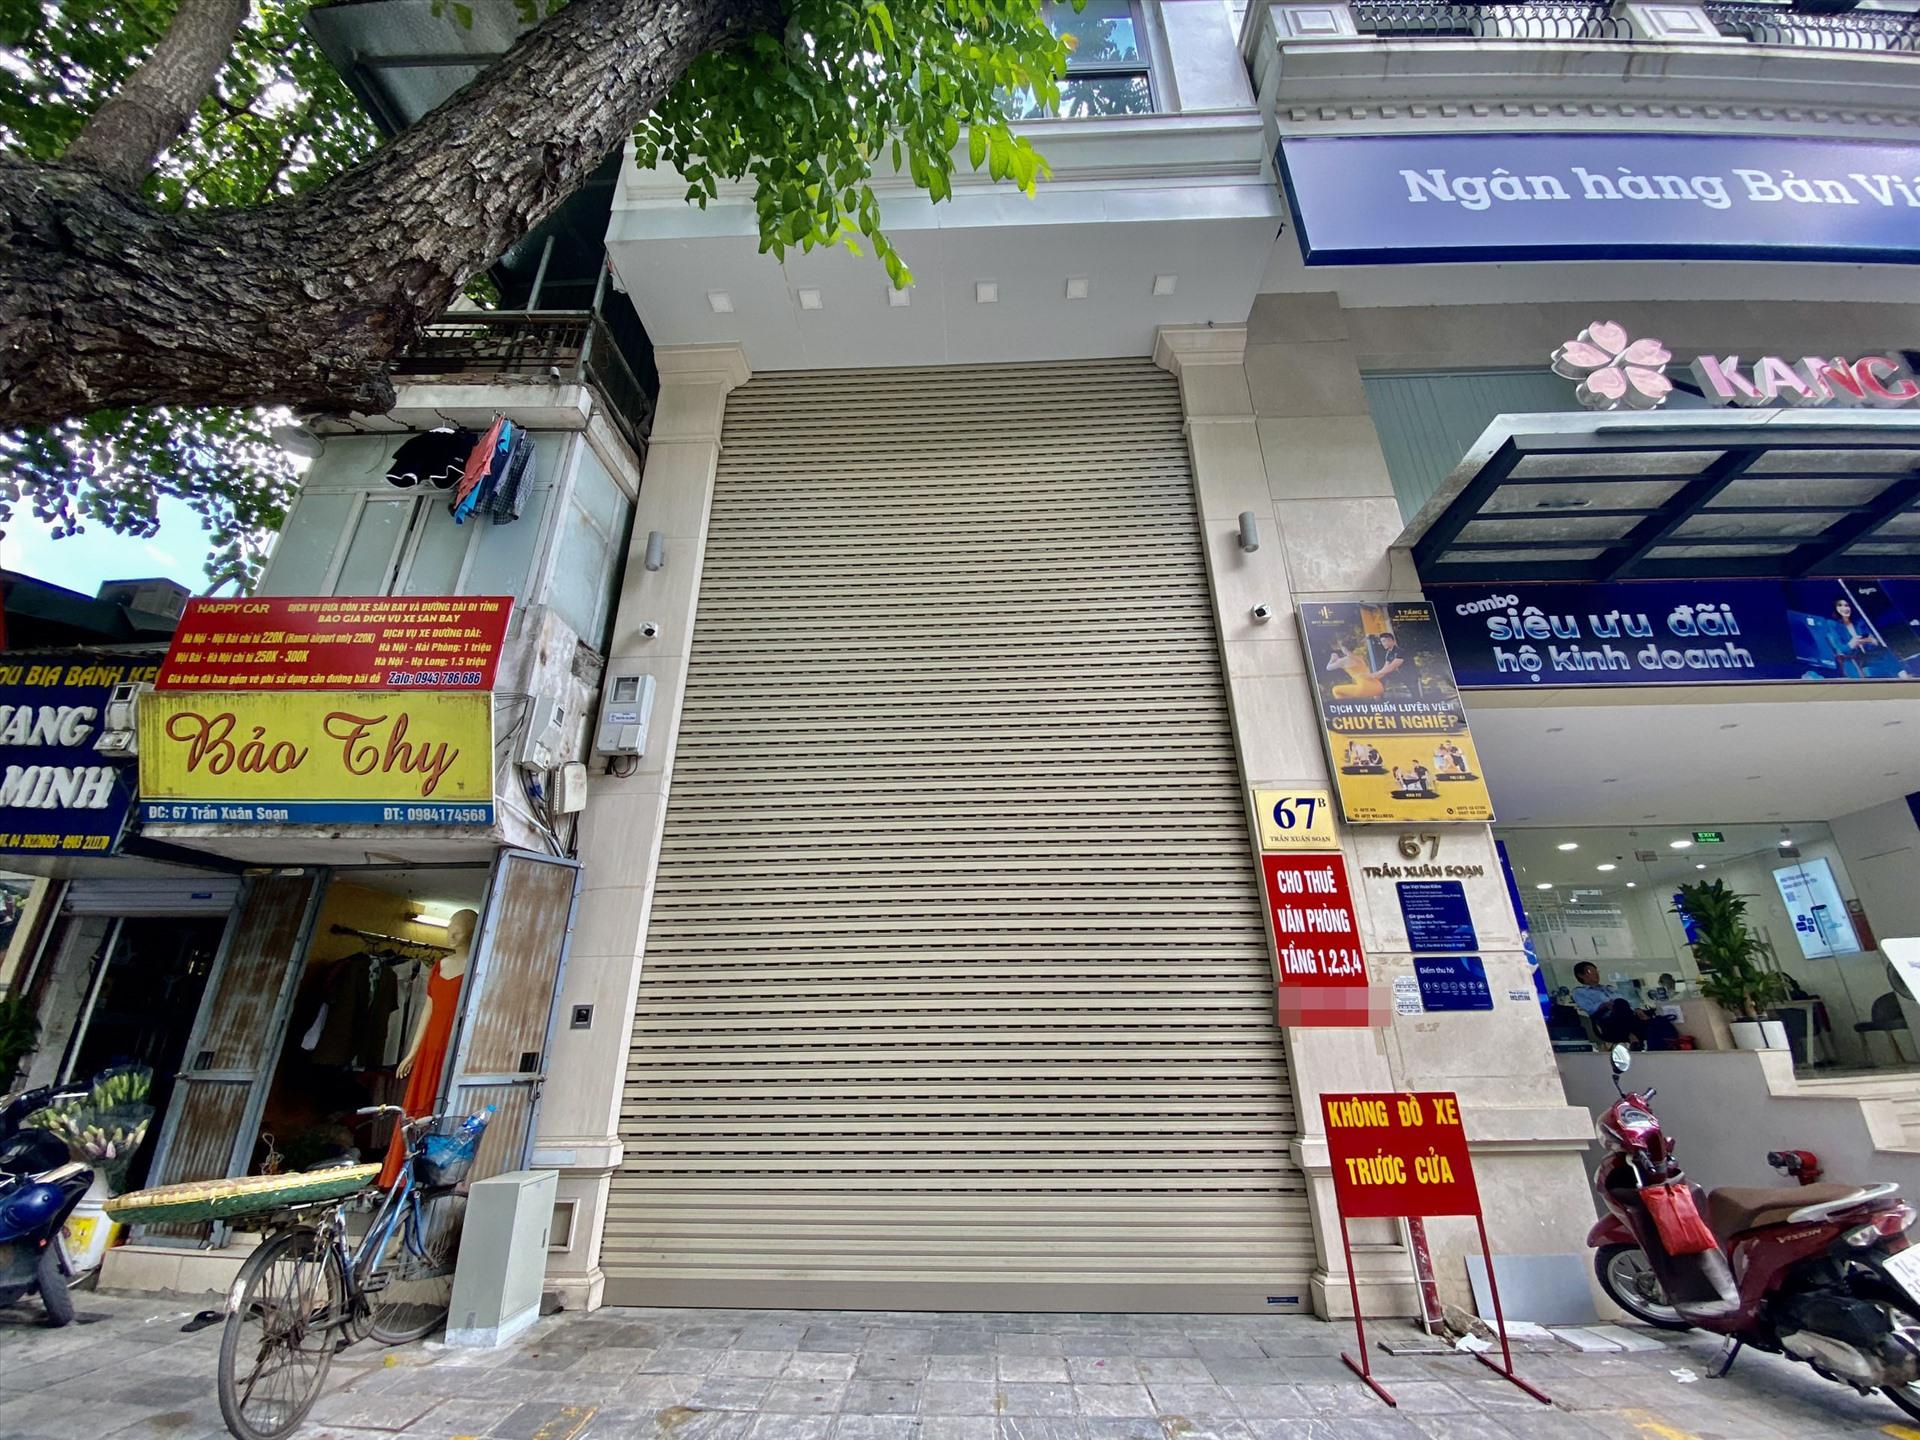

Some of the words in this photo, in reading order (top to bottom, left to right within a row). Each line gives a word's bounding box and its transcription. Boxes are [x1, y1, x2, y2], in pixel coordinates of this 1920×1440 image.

[1399, 167, 1570, 211] Ngân
[1571, 166, 1732, 209] hàng
[1731, 168, 1861, 206] Bản
[197, 604, 242, 613] HAPPY
[243, 604, 270, 613] CAR
[359, 604, 371, 612] XE
[391, 603, 407, 612] BAY
[1456, 594, 1520, 616] combo
[402, 615, 416, 623] XE
[438, 615, 460, 623] BAY
[1486, 606, 1581, 641] siêu
[1589, 610, 1654, 639] ưu
[1666, 603, 1741, 637] đãi
[261, 631, 285, 644] 220K
[383, 629, 404, 640] DỊCH
[419, 630, 431, 638] XE
[254, 651, 278, 663] 250K
[285, 651, 309, 663] 300K
[378, 642, 390, 651] Hà
[392, 642, 407, 653] Nội
[431, 642, 461, 653] Phòng:
[471, 643, 492, 653] triệu
[374, 657, 386, 666] Hà
[387, 657, 403, 668] Nội
[411, 657, 423, 668] Hạ
[424, 657, 449, 667] Long:
[450, 658, 464, 666] 1.5
[465, 657, 487, 668] triệu
[1493, 645, 1543, 682] hộ
[1548, 644, 1631, 672] kinh
[1637, 642, 1755, 671] doanh
[387, 672, 414, 685] Zalo:
[415, 672, 439, 685] 0943
[440, 672, 460, 685] 786
[461, 672, 481, 685] 686
[1330, 704, 1353, 716] DỊCH
[1354, 703, 1369, 714] VỤ
[1371, 701, 1397, 713] HUẤN
[1399, 702, 1431, 714] LUYỆN
[0, 705, 98, 746] ANG
[1332, 713, 1397, 730] CHUYÊN
[1402, 712, 1459, 732] NGHIỆP
[165, 712, 308, 775] Bảo
[323, 711, 459, 797] Thy
[0, 765, 116, 809] MINH
[149, 806, 169, 819] ĐC:
[172, 806, 188, 819] 67
[191, 804, 218, 820] Trần
[221, 806, 253, 820] Xuân
[256, 807, 289, 822] Soạn
[383, 807, 404, 820] ĐT:
[407, 808, 486, 822] 0984174568
[1399, 832, 1441, 860] 67
[1277, 870, 1304, 894] CHO
[1304, 865, 1337, 894] THUÊ
[1403, 863, 1442, 878] XUÂN
[1444, 865, 1484, 879] SOẠN
[1277, 904, 1305, 933] VĂN
[1306, 903, 1351, 933] PHÒNG
[1281, 940, 1317, 974] TẦNG
[1318, 949, 1362, 977] 1,2,3,4
[1436, 966, 1446, 974] thu
[1328, 1096, 1390, 1128] KHÔNG
[1432, 1098, 1459, 1125] XE
[1415, 1146, 1455, 1184] CỬA
